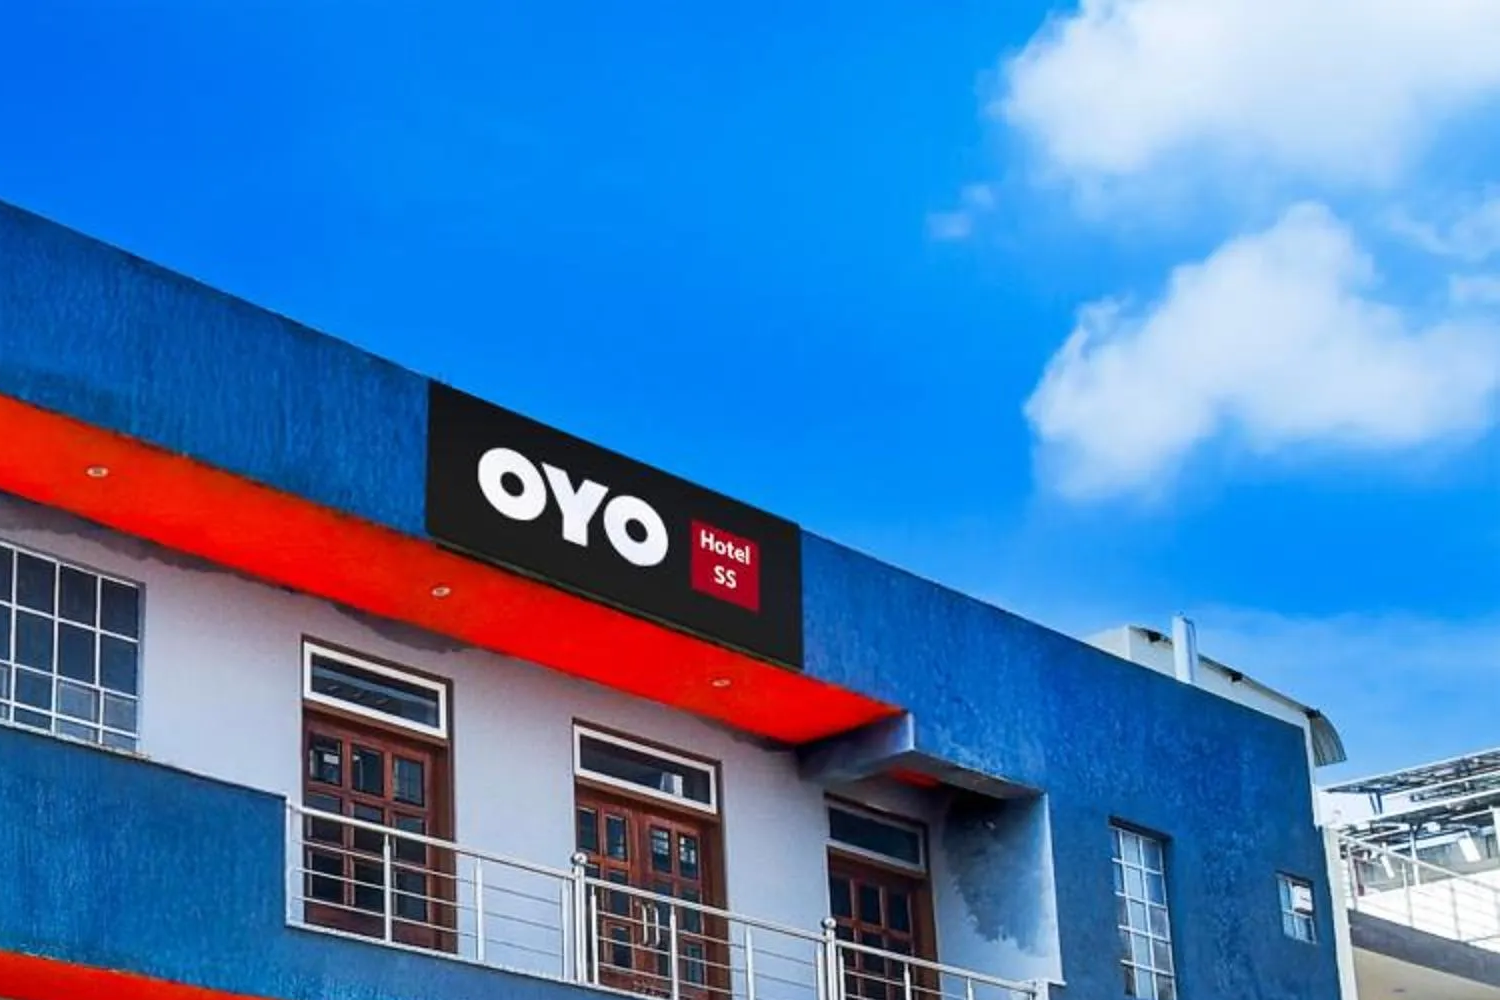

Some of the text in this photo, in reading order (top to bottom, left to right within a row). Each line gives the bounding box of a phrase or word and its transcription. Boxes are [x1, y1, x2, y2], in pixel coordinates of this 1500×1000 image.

[477, 447, 668, 567] OYO
[699, 529, 750, 565] Hotel
[713, 565, 737, 589] SS
